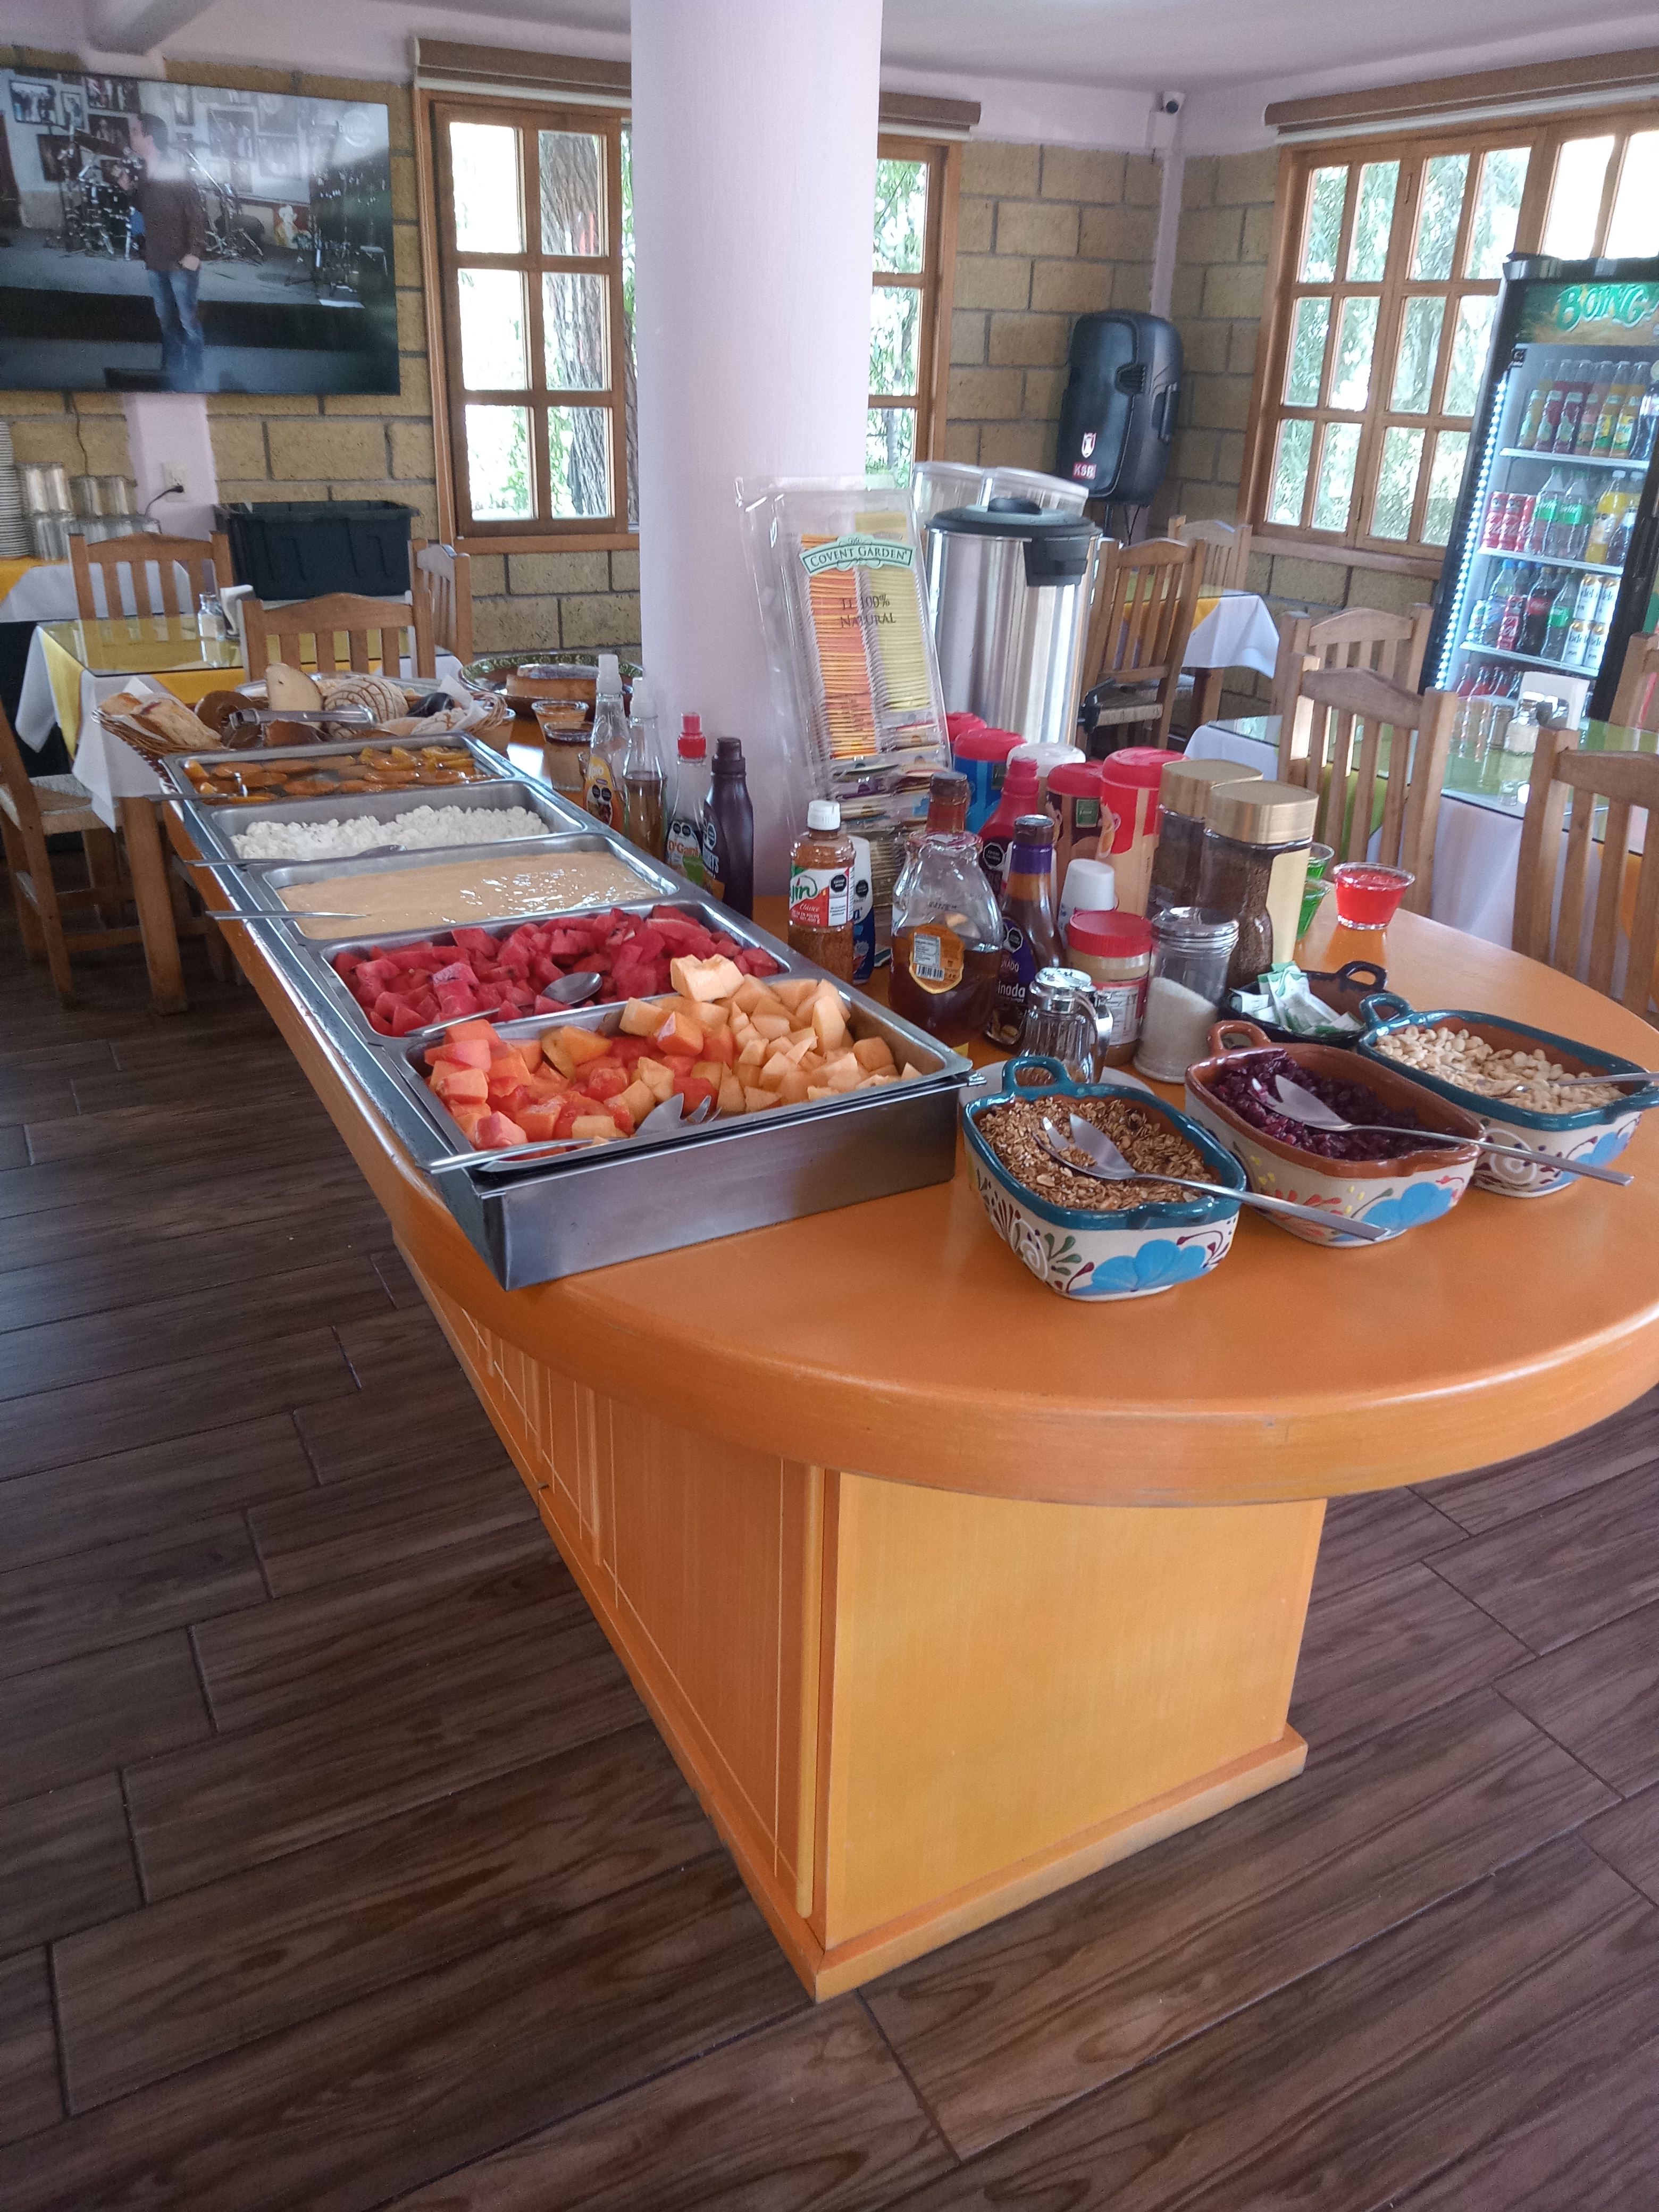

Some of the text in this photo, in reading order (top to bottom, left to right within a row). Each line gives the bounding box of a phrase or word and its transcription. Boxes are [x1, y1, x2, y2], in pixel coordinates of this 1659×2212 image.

[1073, 463, 1095, 478] KSR
[810, 546, 908, 567] COVENT GARDEN
[859, 593, 891, 610] 100%
[840, 612, 896, 628] NATURAL
[998, 981, 1026, 999] inada
